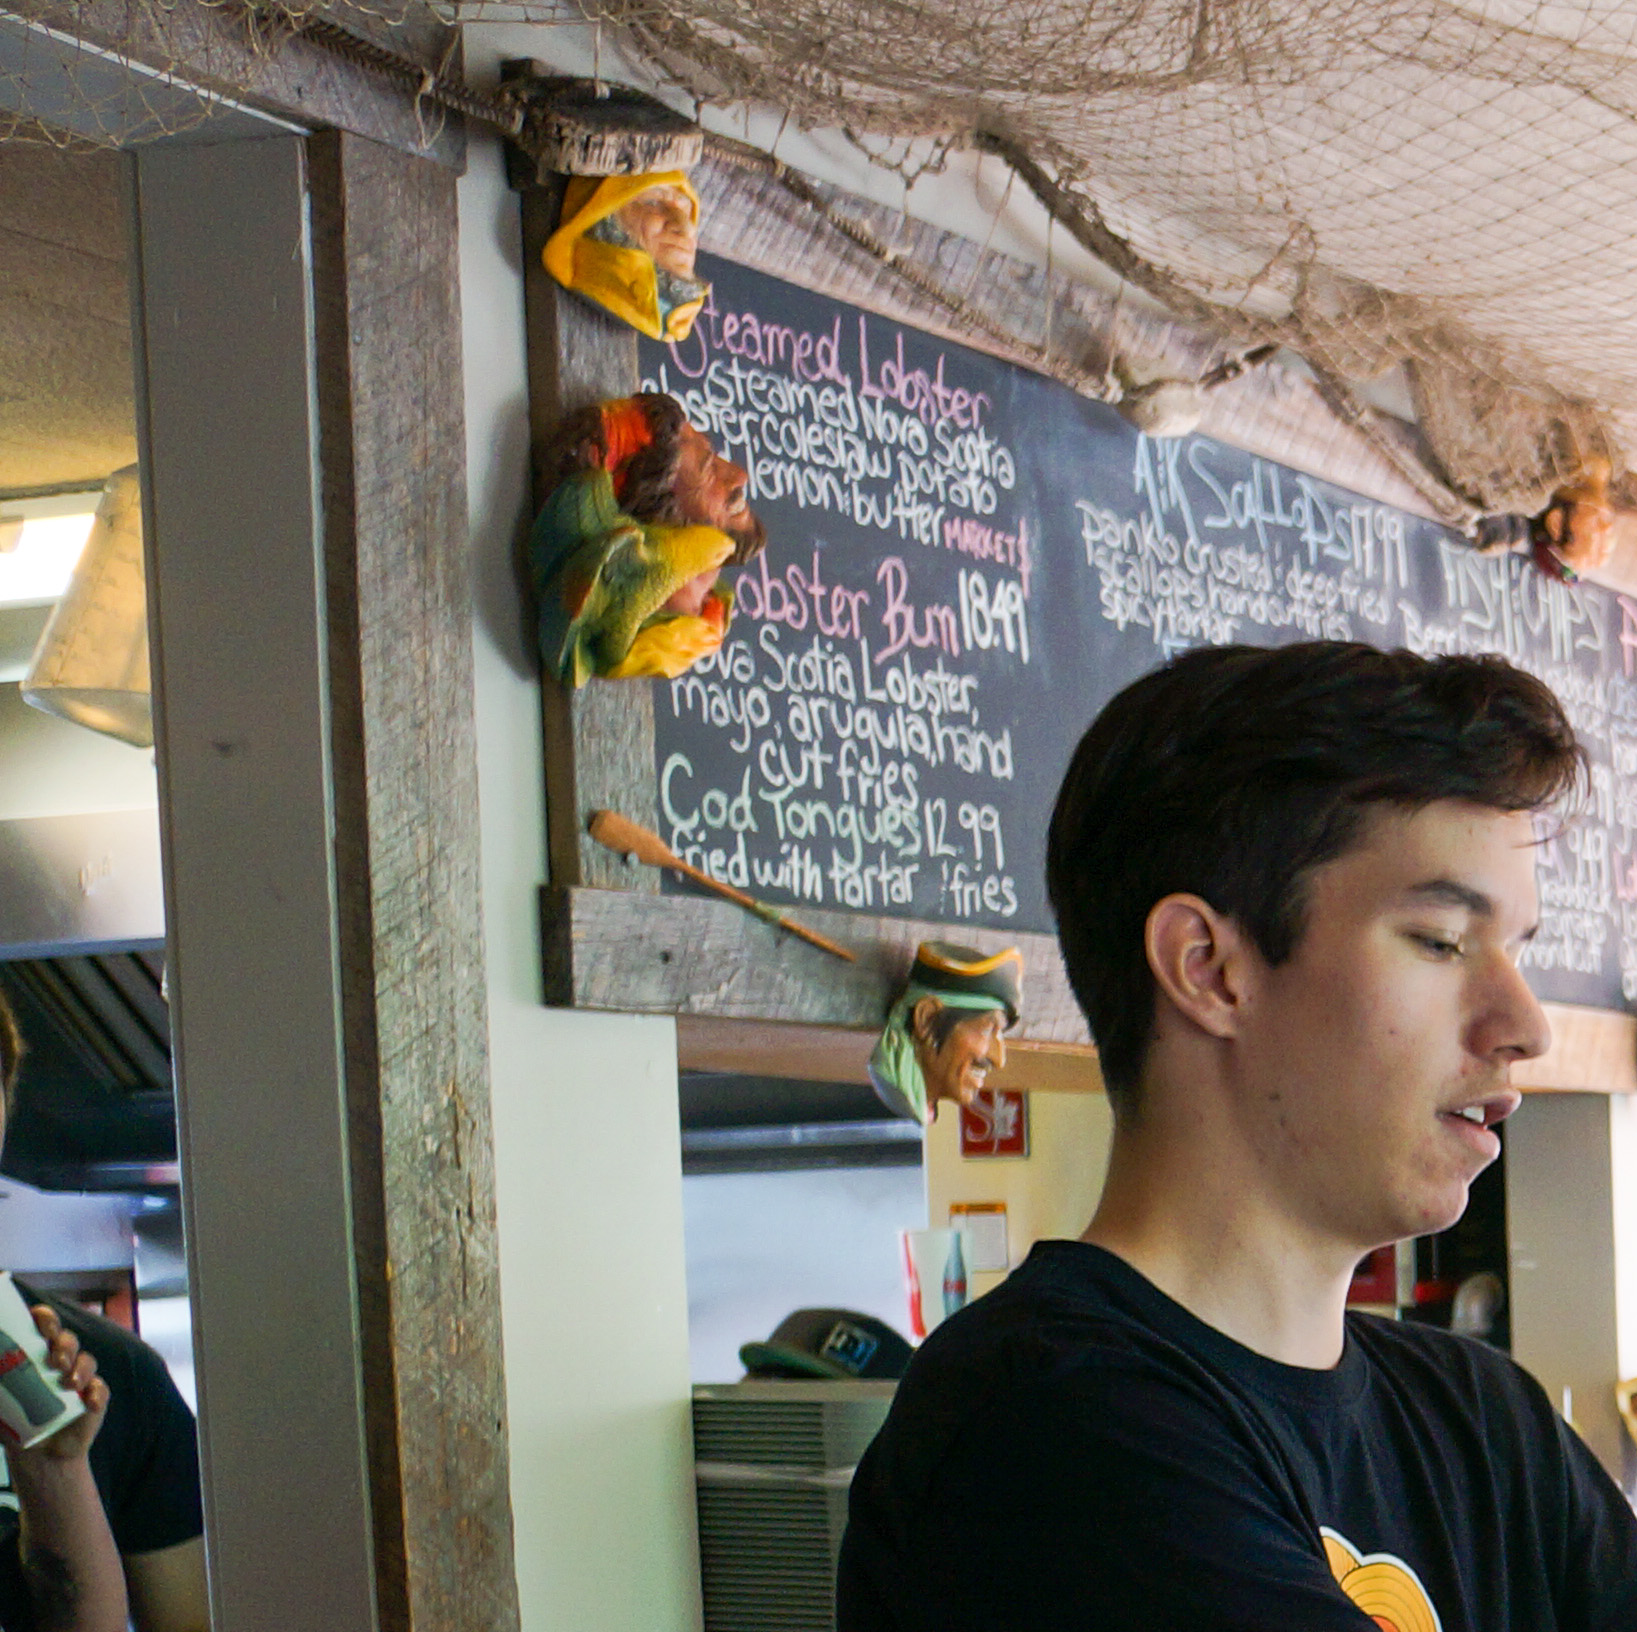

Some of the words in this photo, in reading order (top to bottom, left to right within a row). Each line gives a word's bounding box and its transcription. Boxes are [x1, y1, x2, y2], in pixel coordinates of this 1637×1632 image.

[858, 315, 992, 429] Lobster
[703, 356, 860, 433] Steamed
[859, 395, 929, 455] Nova
[934, 418, 1015, 490] Scotia
[762, 412, 894, 482] coleslaw
[898, 452, 997, 516] potato
[745, 444, 843, 512] lemon
[853, 480, 946, 547] butter
[1074, 499, 1181, 567] Panko
[728, 550, 871, 641] obster
[694, 638, 755, 684] ova
[759, 624, 857, 702] Scotia
[759, 738, 833, 789] cut
[837, 739, 919, 811] fries
[935, 712, 1014, 782] hand
[661, 752, 757, 834] Cod
[758, 784, 923, 869] Tongues
[754, 846, 823, 903] with
[828, 854, 921, 909] tartar
[949, 862, 1019, 918] fries
